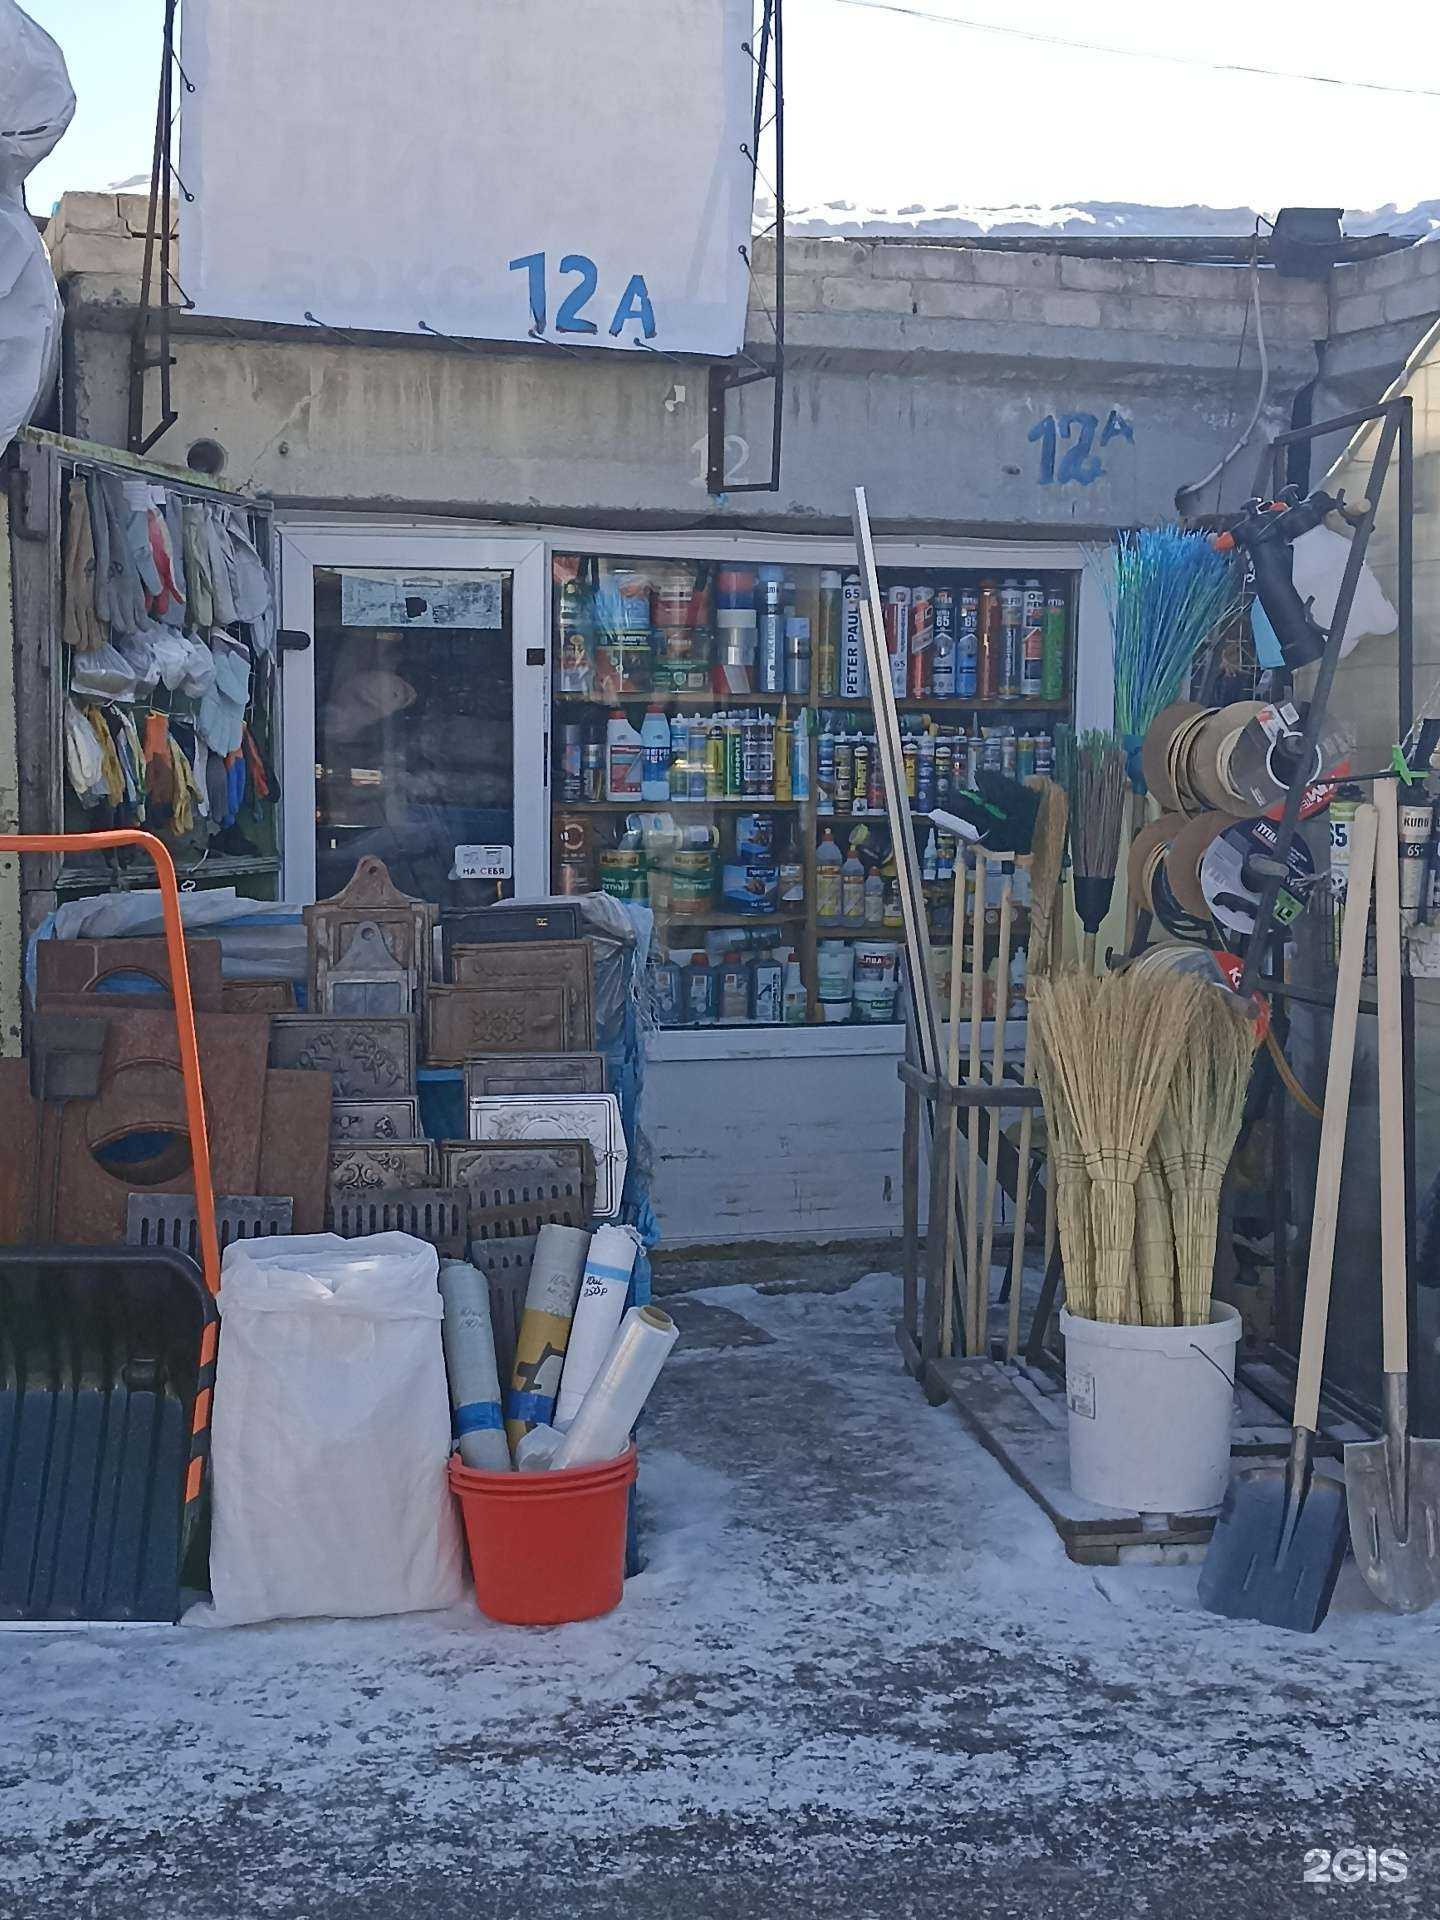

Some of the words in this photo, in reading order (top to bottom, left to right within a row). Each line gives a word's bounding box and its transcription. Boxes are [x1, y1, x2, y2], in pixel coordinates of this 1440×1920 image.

[845, 588, 860, 599] 65
[848, 607, 859, 643] PAUL
[847, 647, 858, 695] PETER
[480, 867, 505, 875] СЕБЯ
